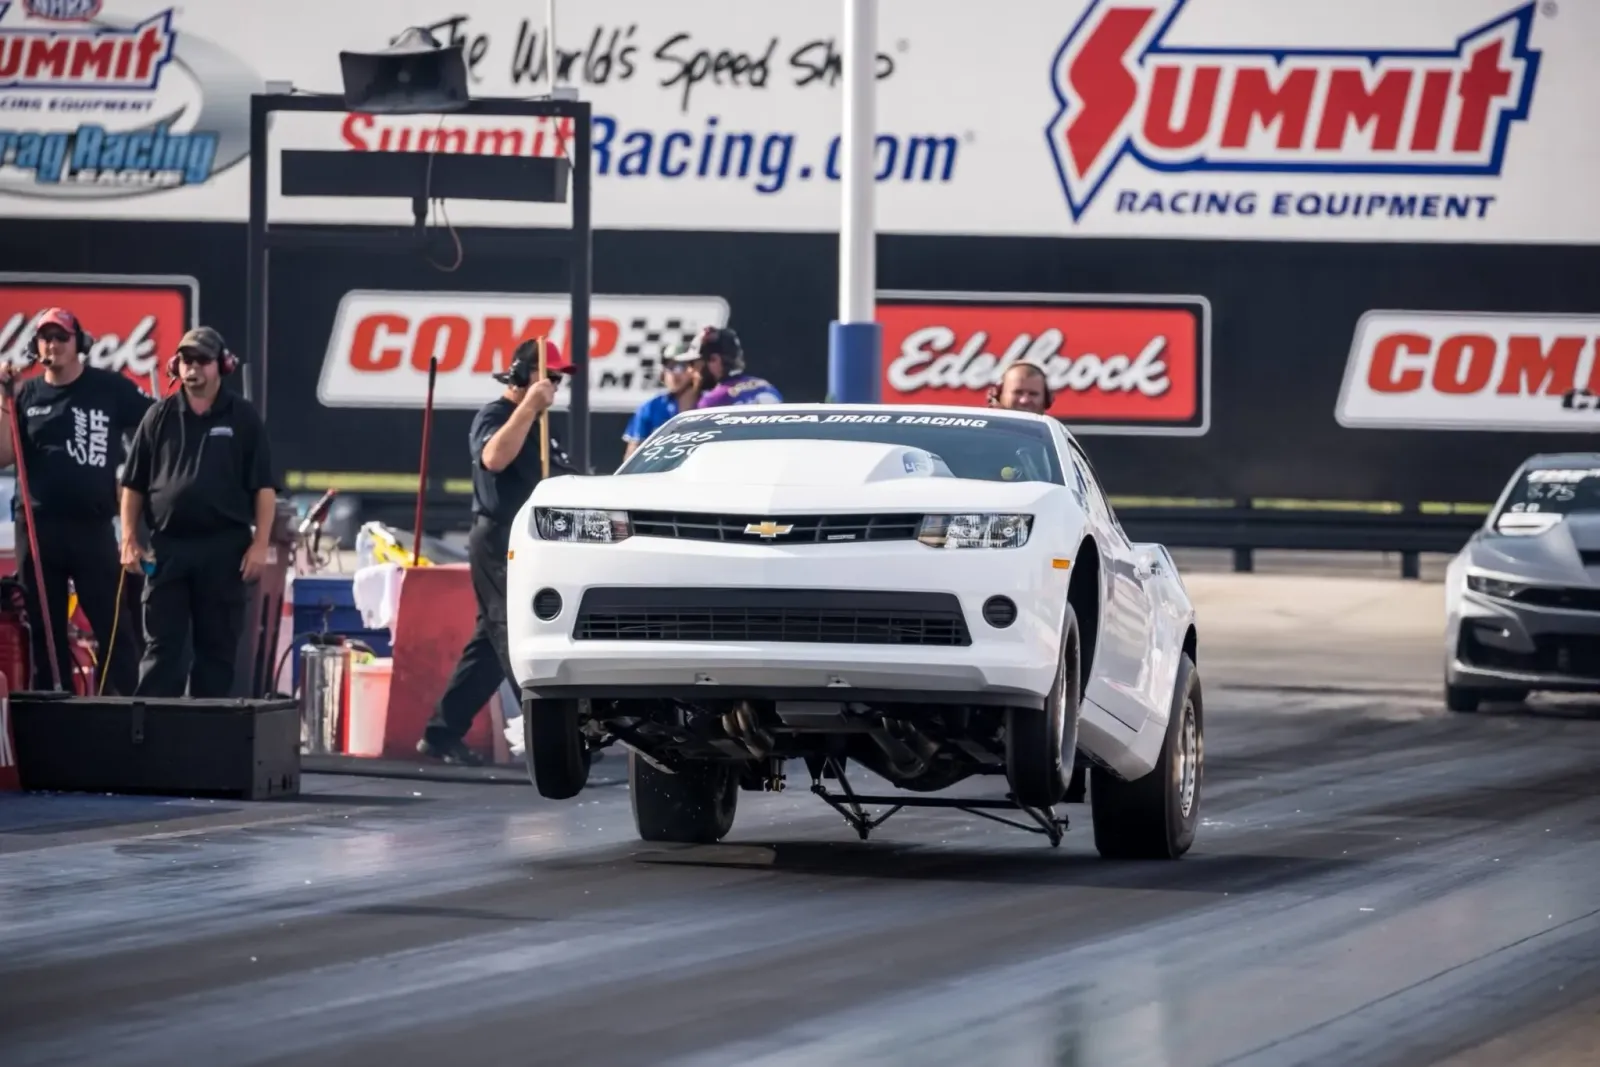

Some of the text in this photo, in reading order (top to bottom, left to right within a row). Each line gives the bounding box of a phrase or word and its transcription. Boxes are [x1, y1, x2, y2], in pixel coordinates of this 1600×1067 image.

[428, 14, 489, 84] Te
[654, 33, 777, 112] Speed
[790, 38, 894, 88] Shp
[70, 120, 219, 185] Racing
[1115, 190, 1496, 219] RACING EQUIPMENT
[887, 326, 1170, 396] Edelbrock
[1367, 332, 1600, 396] COM
[66, 407, 88, 465] Event
[88, 409, 110, 468] STAFF
[823, 414, 889, 425] DRAG
[896, 415, 988, 429] RACING
